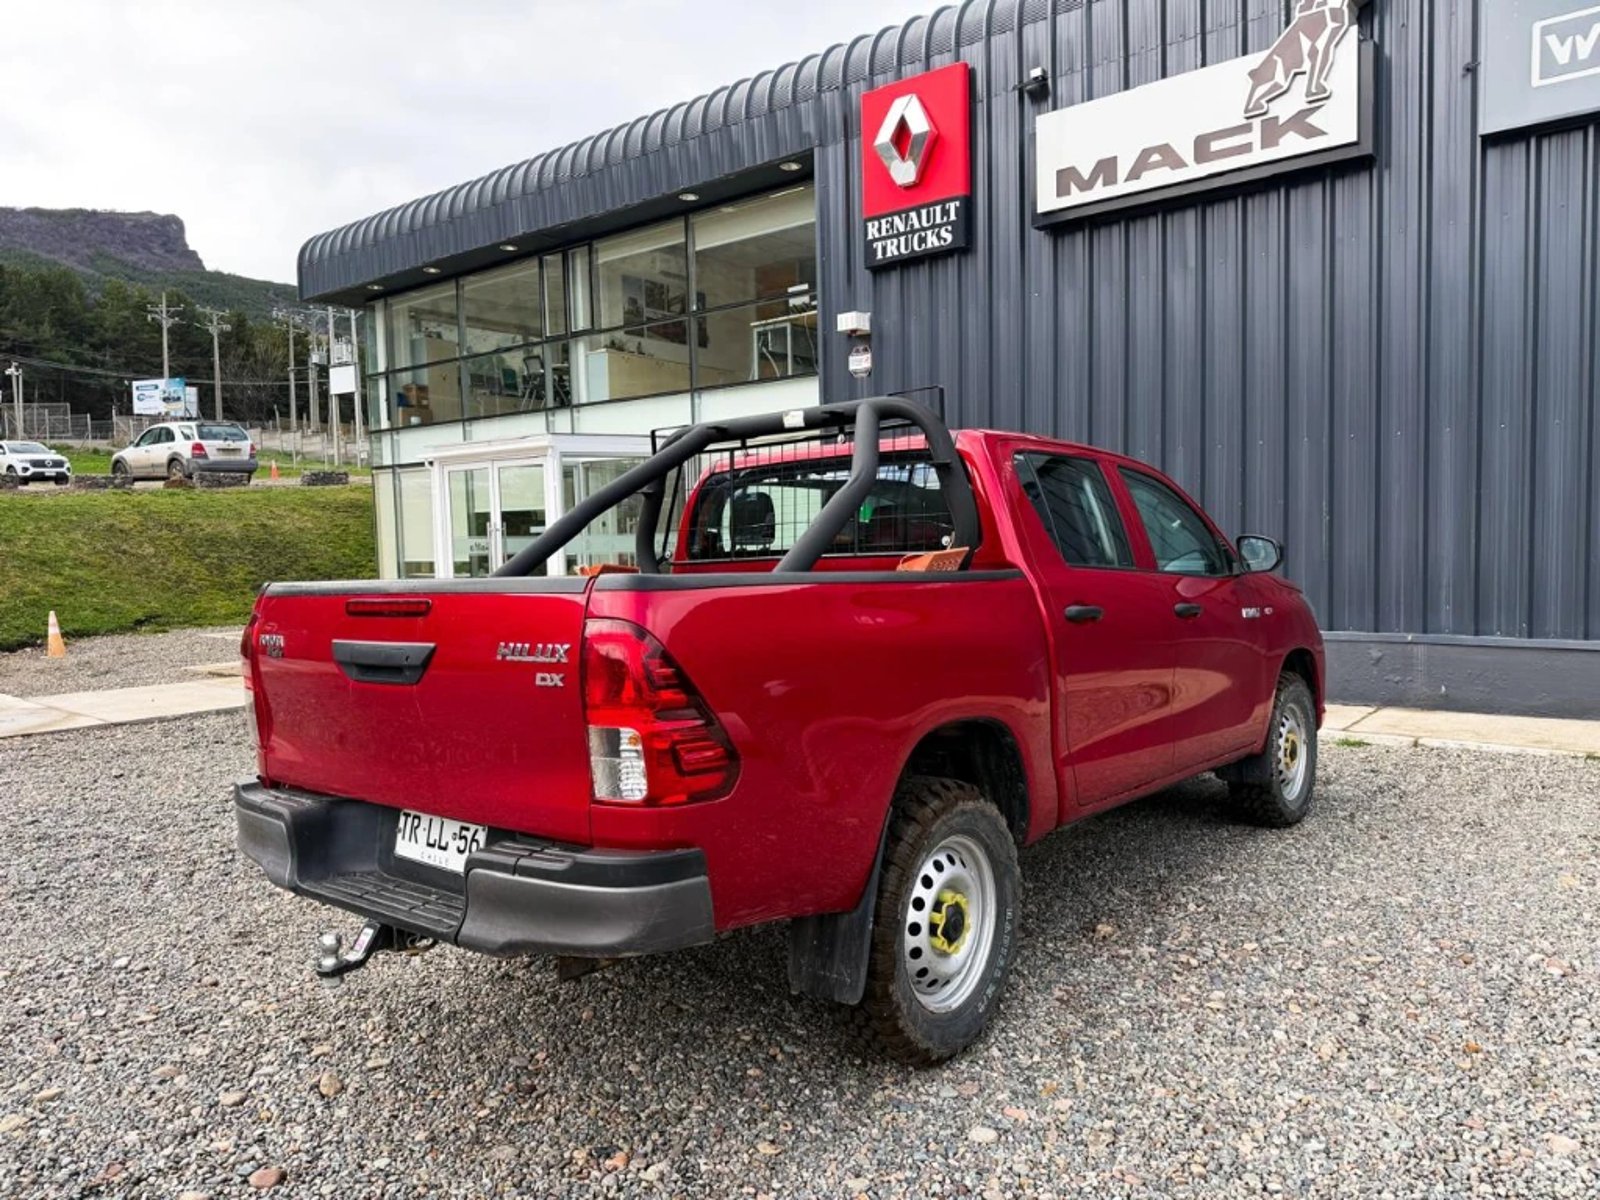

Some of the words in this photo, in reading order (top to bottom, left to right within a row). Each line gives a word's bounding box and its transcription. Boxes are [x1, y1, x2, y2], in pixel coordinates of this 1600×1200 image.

[1056, 103, 1329, 198] MACK
[866, 200, 960, 240] RENAULT
[873, 225, 953, 260] TRUCKS
[496, 641, 571, 663] HILUX
[535, 672, 565, 687] DX
